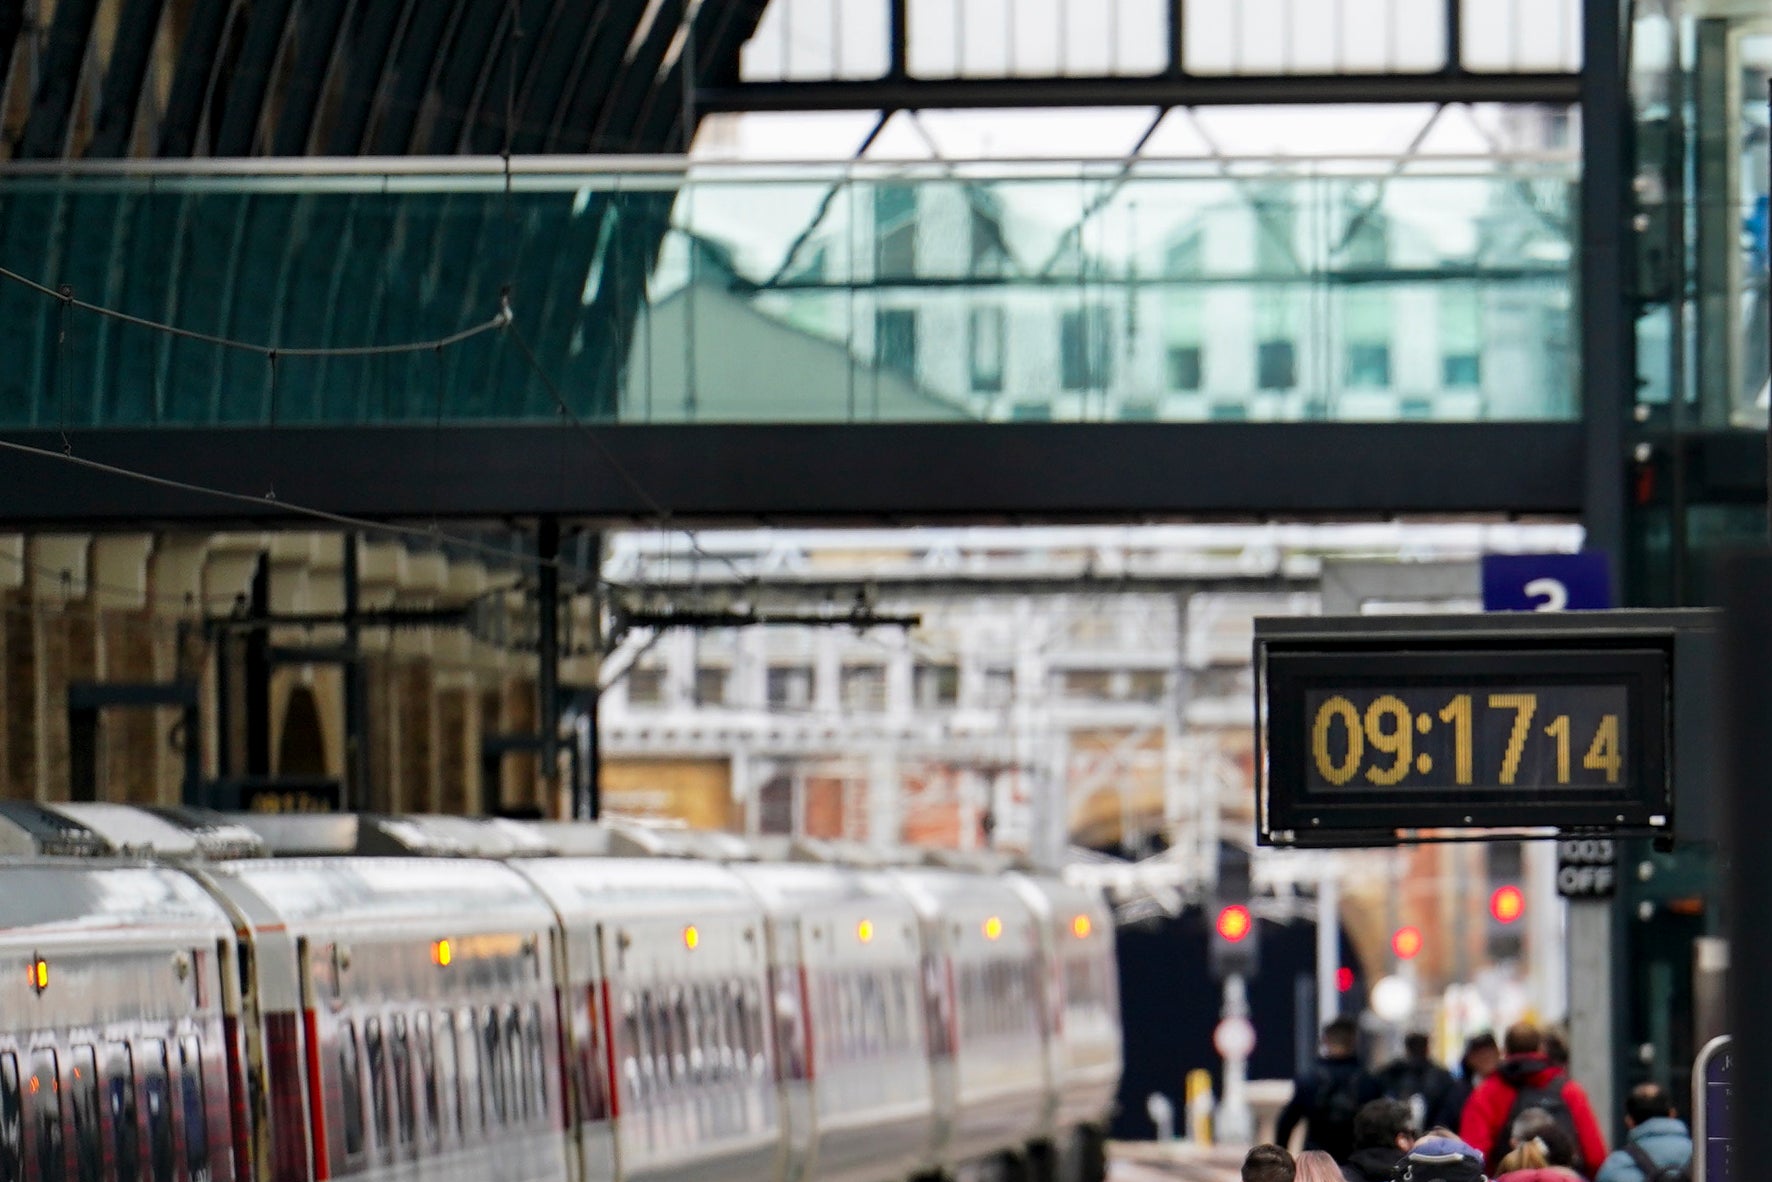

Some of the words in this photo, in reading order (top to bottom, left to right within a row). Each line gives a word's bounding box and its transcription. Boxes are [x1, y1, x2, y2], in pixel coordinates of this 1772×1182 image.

[1313, 694, 1536, 784] 09:17
[1545, 716, 1621, 783] 14
[1559, 865, 1614, 894] OFF
